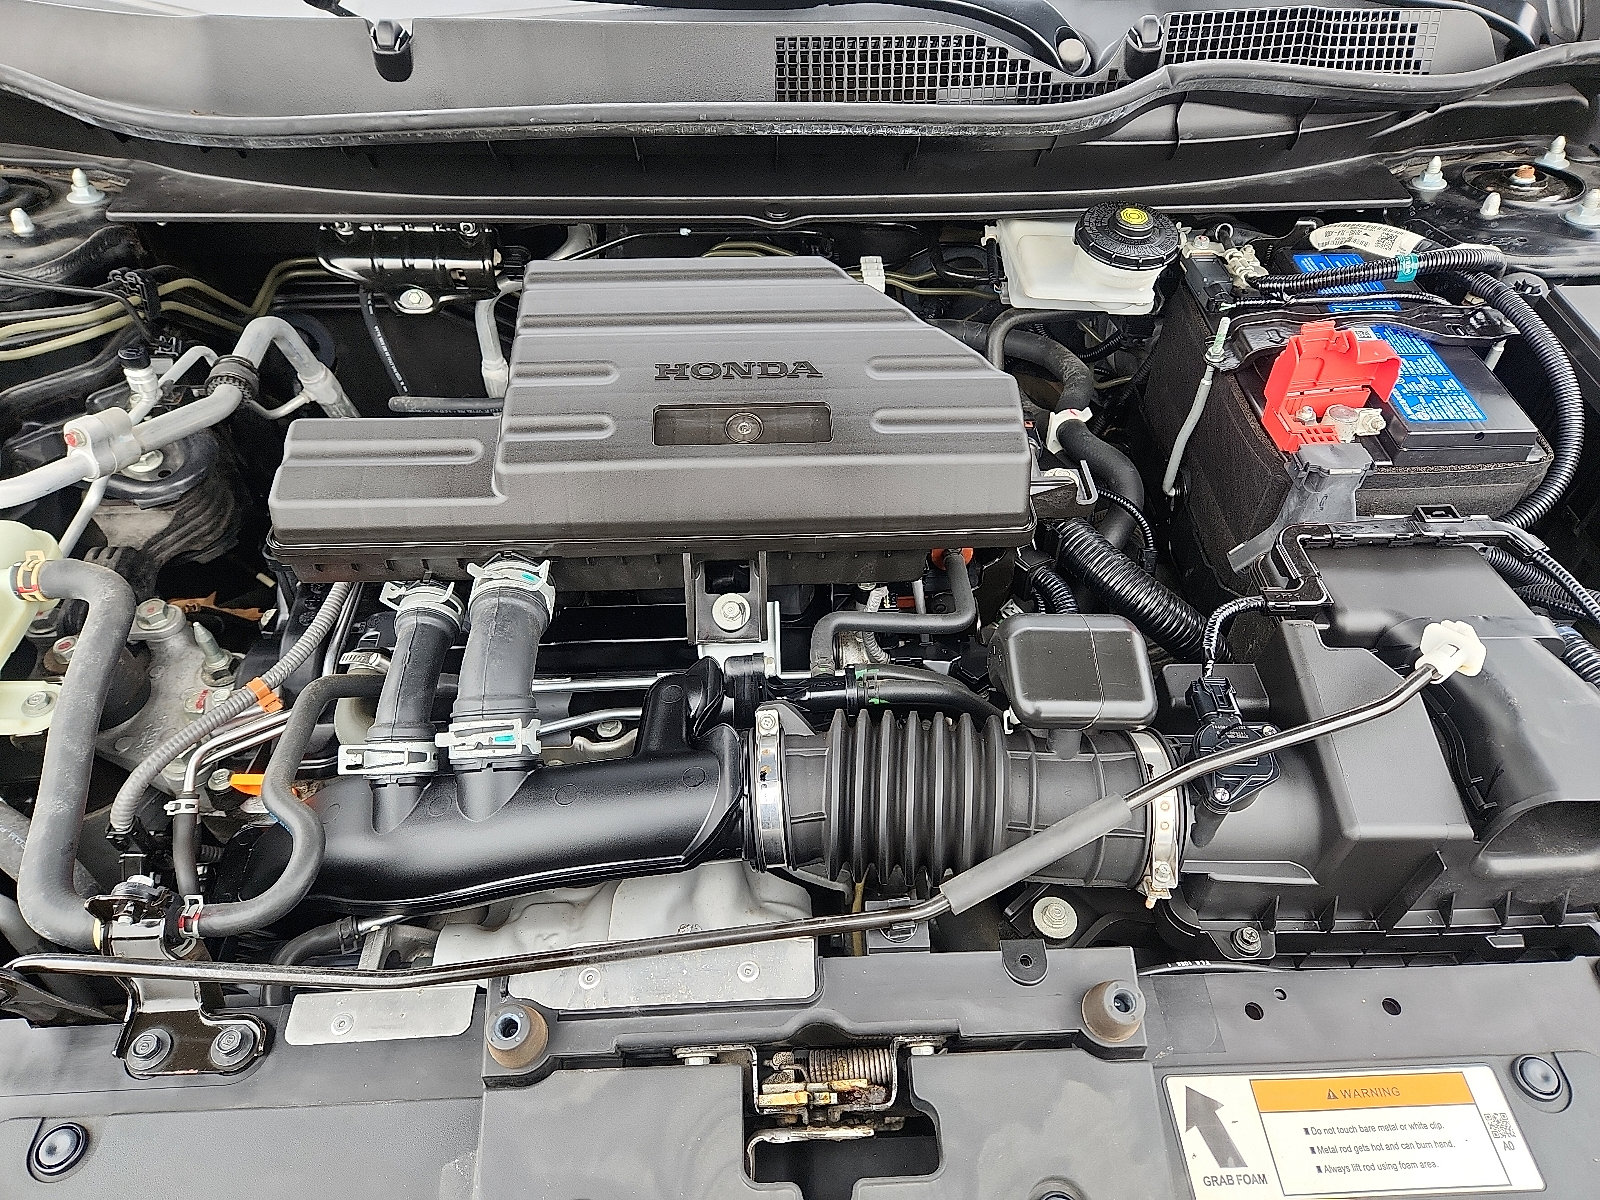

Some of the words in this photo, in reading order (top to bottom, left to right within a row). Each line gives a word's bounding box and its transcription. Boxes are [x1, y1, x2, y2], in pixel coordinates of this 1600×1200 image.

[654, 360, 823, 380] HONDA
[1340, 1087, 1400, 1099] WARNING
[1310, 1126, 1322, 1136] Do
[1324, 1125, 1337, 1135] not
[1337, 1124, 1357, 1134] touch
[1358, 1124, 1377, 1133] bare
[1378, 1122, 1398, 1132] metal
[1400, 1123, 1408, 1131] or
[1409, 1121, 1428, 1131] white
[1317, 1145, 1338, 1155] Metal
[1339, 1144, 1353, 1153] rod
[1354, 1143, 1370, 1155] gets
[1371, 1142, 1384, 1151] hot
[1385, 1141, 1400, 1151] and
[1401, 1141, 1414, 1150] can
[1434, 1139, 1456, 1149] hand.
[1324, 1164, 1351, 1175] Always
[1351, 1162, 1362, 1172] lift
[1362, 1162, 1376, 1171] rod
[1377, 1161, 1398, 1172] using
[1399, 1160, 1419, 1170] foam
[1203, 1174, 1235, 1187] GRAB
[1236, 1173, 1268, 1186] FOAM
